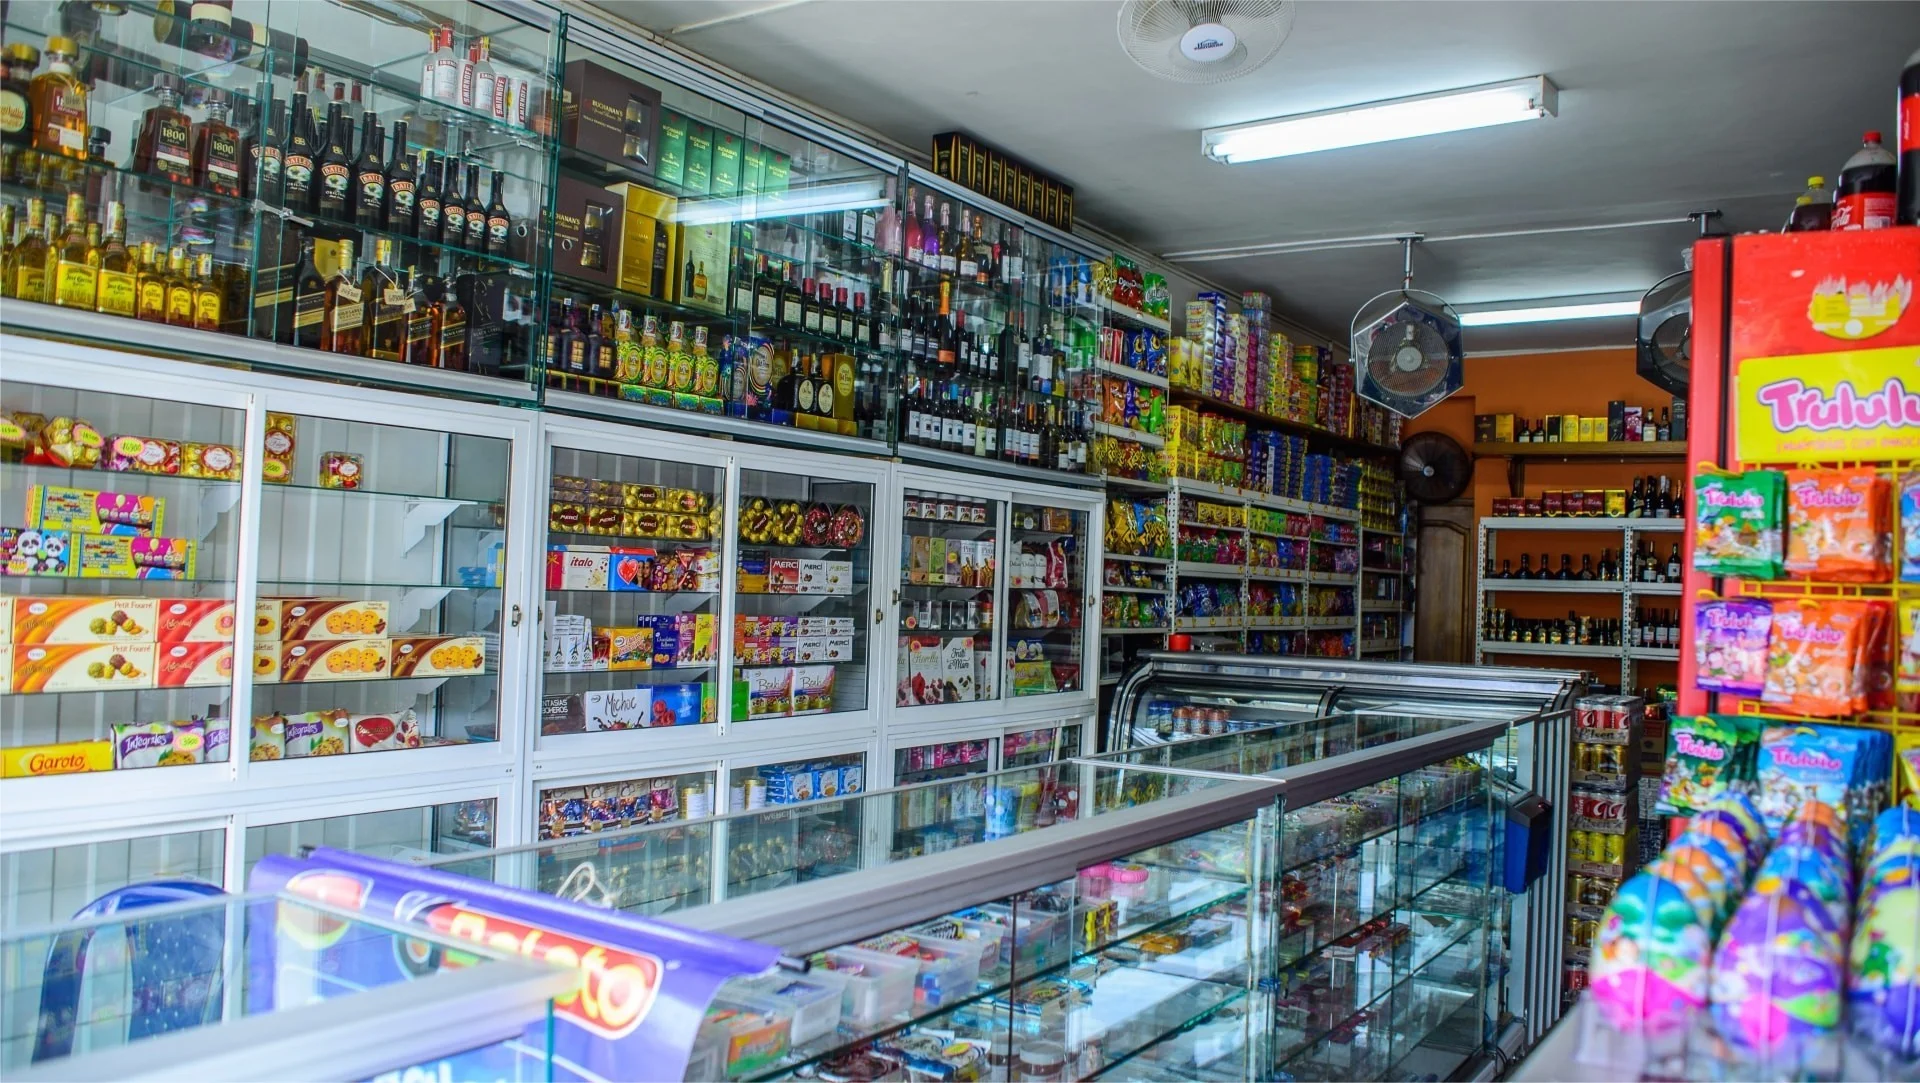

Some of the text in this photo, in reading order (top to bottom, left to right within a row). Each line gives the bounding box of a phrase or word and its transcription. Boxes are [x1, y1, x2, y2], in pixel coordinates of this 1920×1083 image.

[463, 65, 473, 105] SMIRNOFF
[495, 79, 505, 115] SMIRNOFF
[162, 127, 185, 142] 1800
[213, 141, 234, 155] 1800
[570, 556, 593, 567] italo
[114, 601, 128, 609] Petit
[112, 645, 127, 653] Petit
[605, 692, 637, 718] Michoc
[126, 733, 167, 752] Integrales
[30, 752, 86, 773] Garoto
